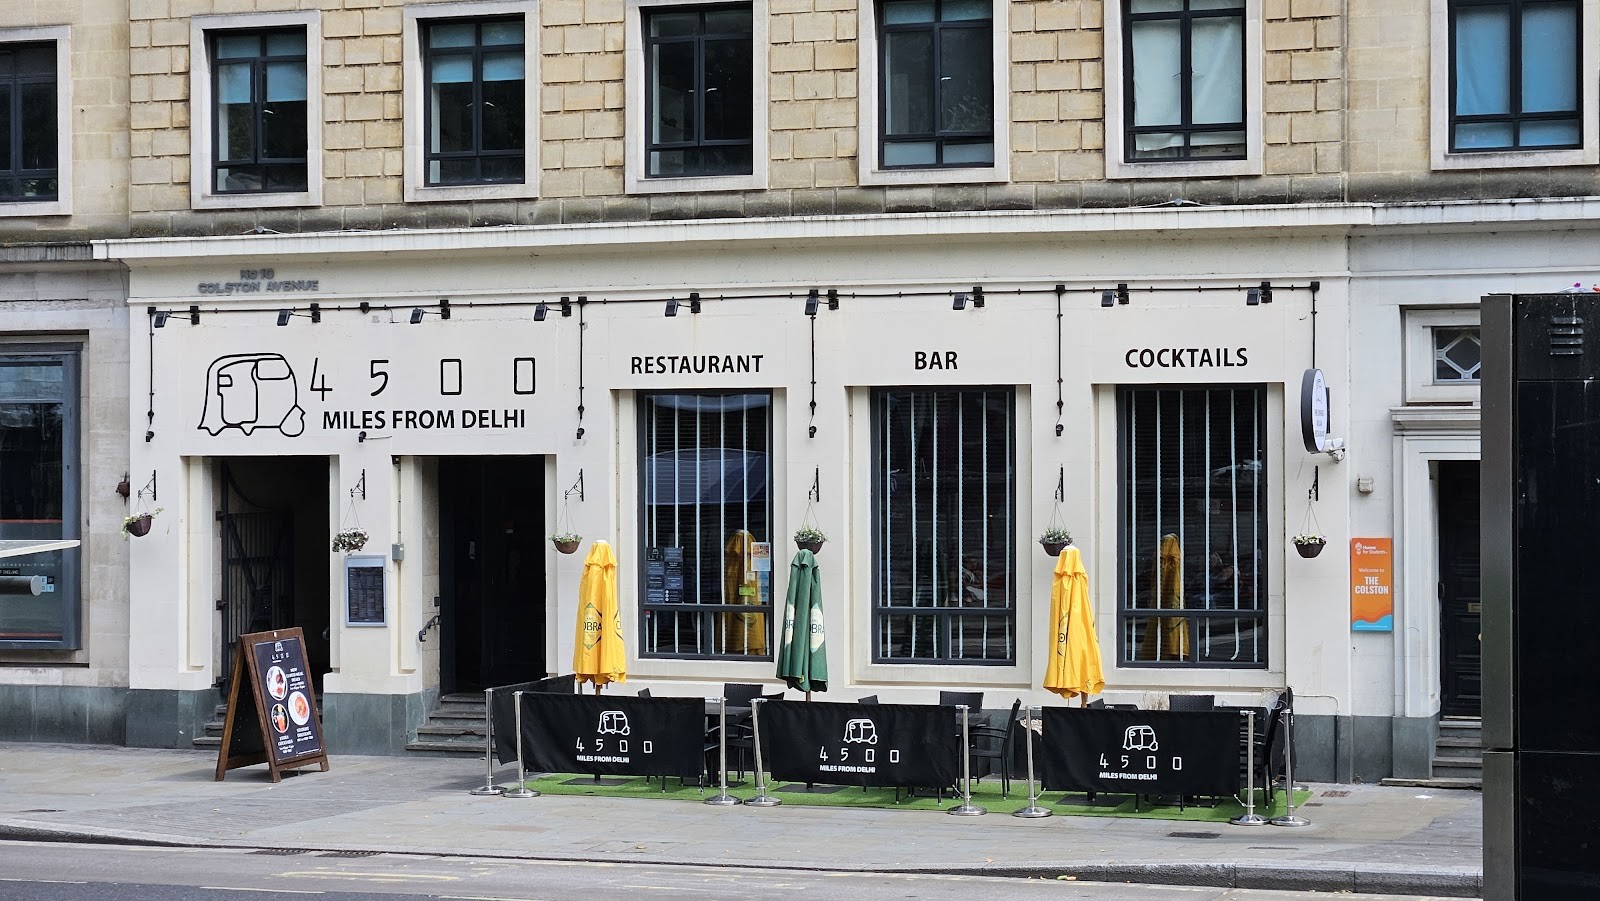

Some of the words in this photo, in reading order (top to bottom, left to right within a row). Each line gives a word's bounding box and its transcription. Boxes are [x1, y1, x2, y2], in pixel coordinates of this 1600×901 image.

[198, 282, 260, 294] COLSTON
[266, 280, 319, 292] AVENUE
[631, 354, 764, 375] RESTAURANT
[914, 351, 958, 370] BAR
[1126, 347, 1248, 368] COCKTAILS
[323, 410, 386, 430] MILES
[392, 409, 455, 429] FROM
[461, 409, 525, 428] DELHI
[1355, 585, 1389, 595] COLSTON
[1364, 576, 1380, 586] THE
